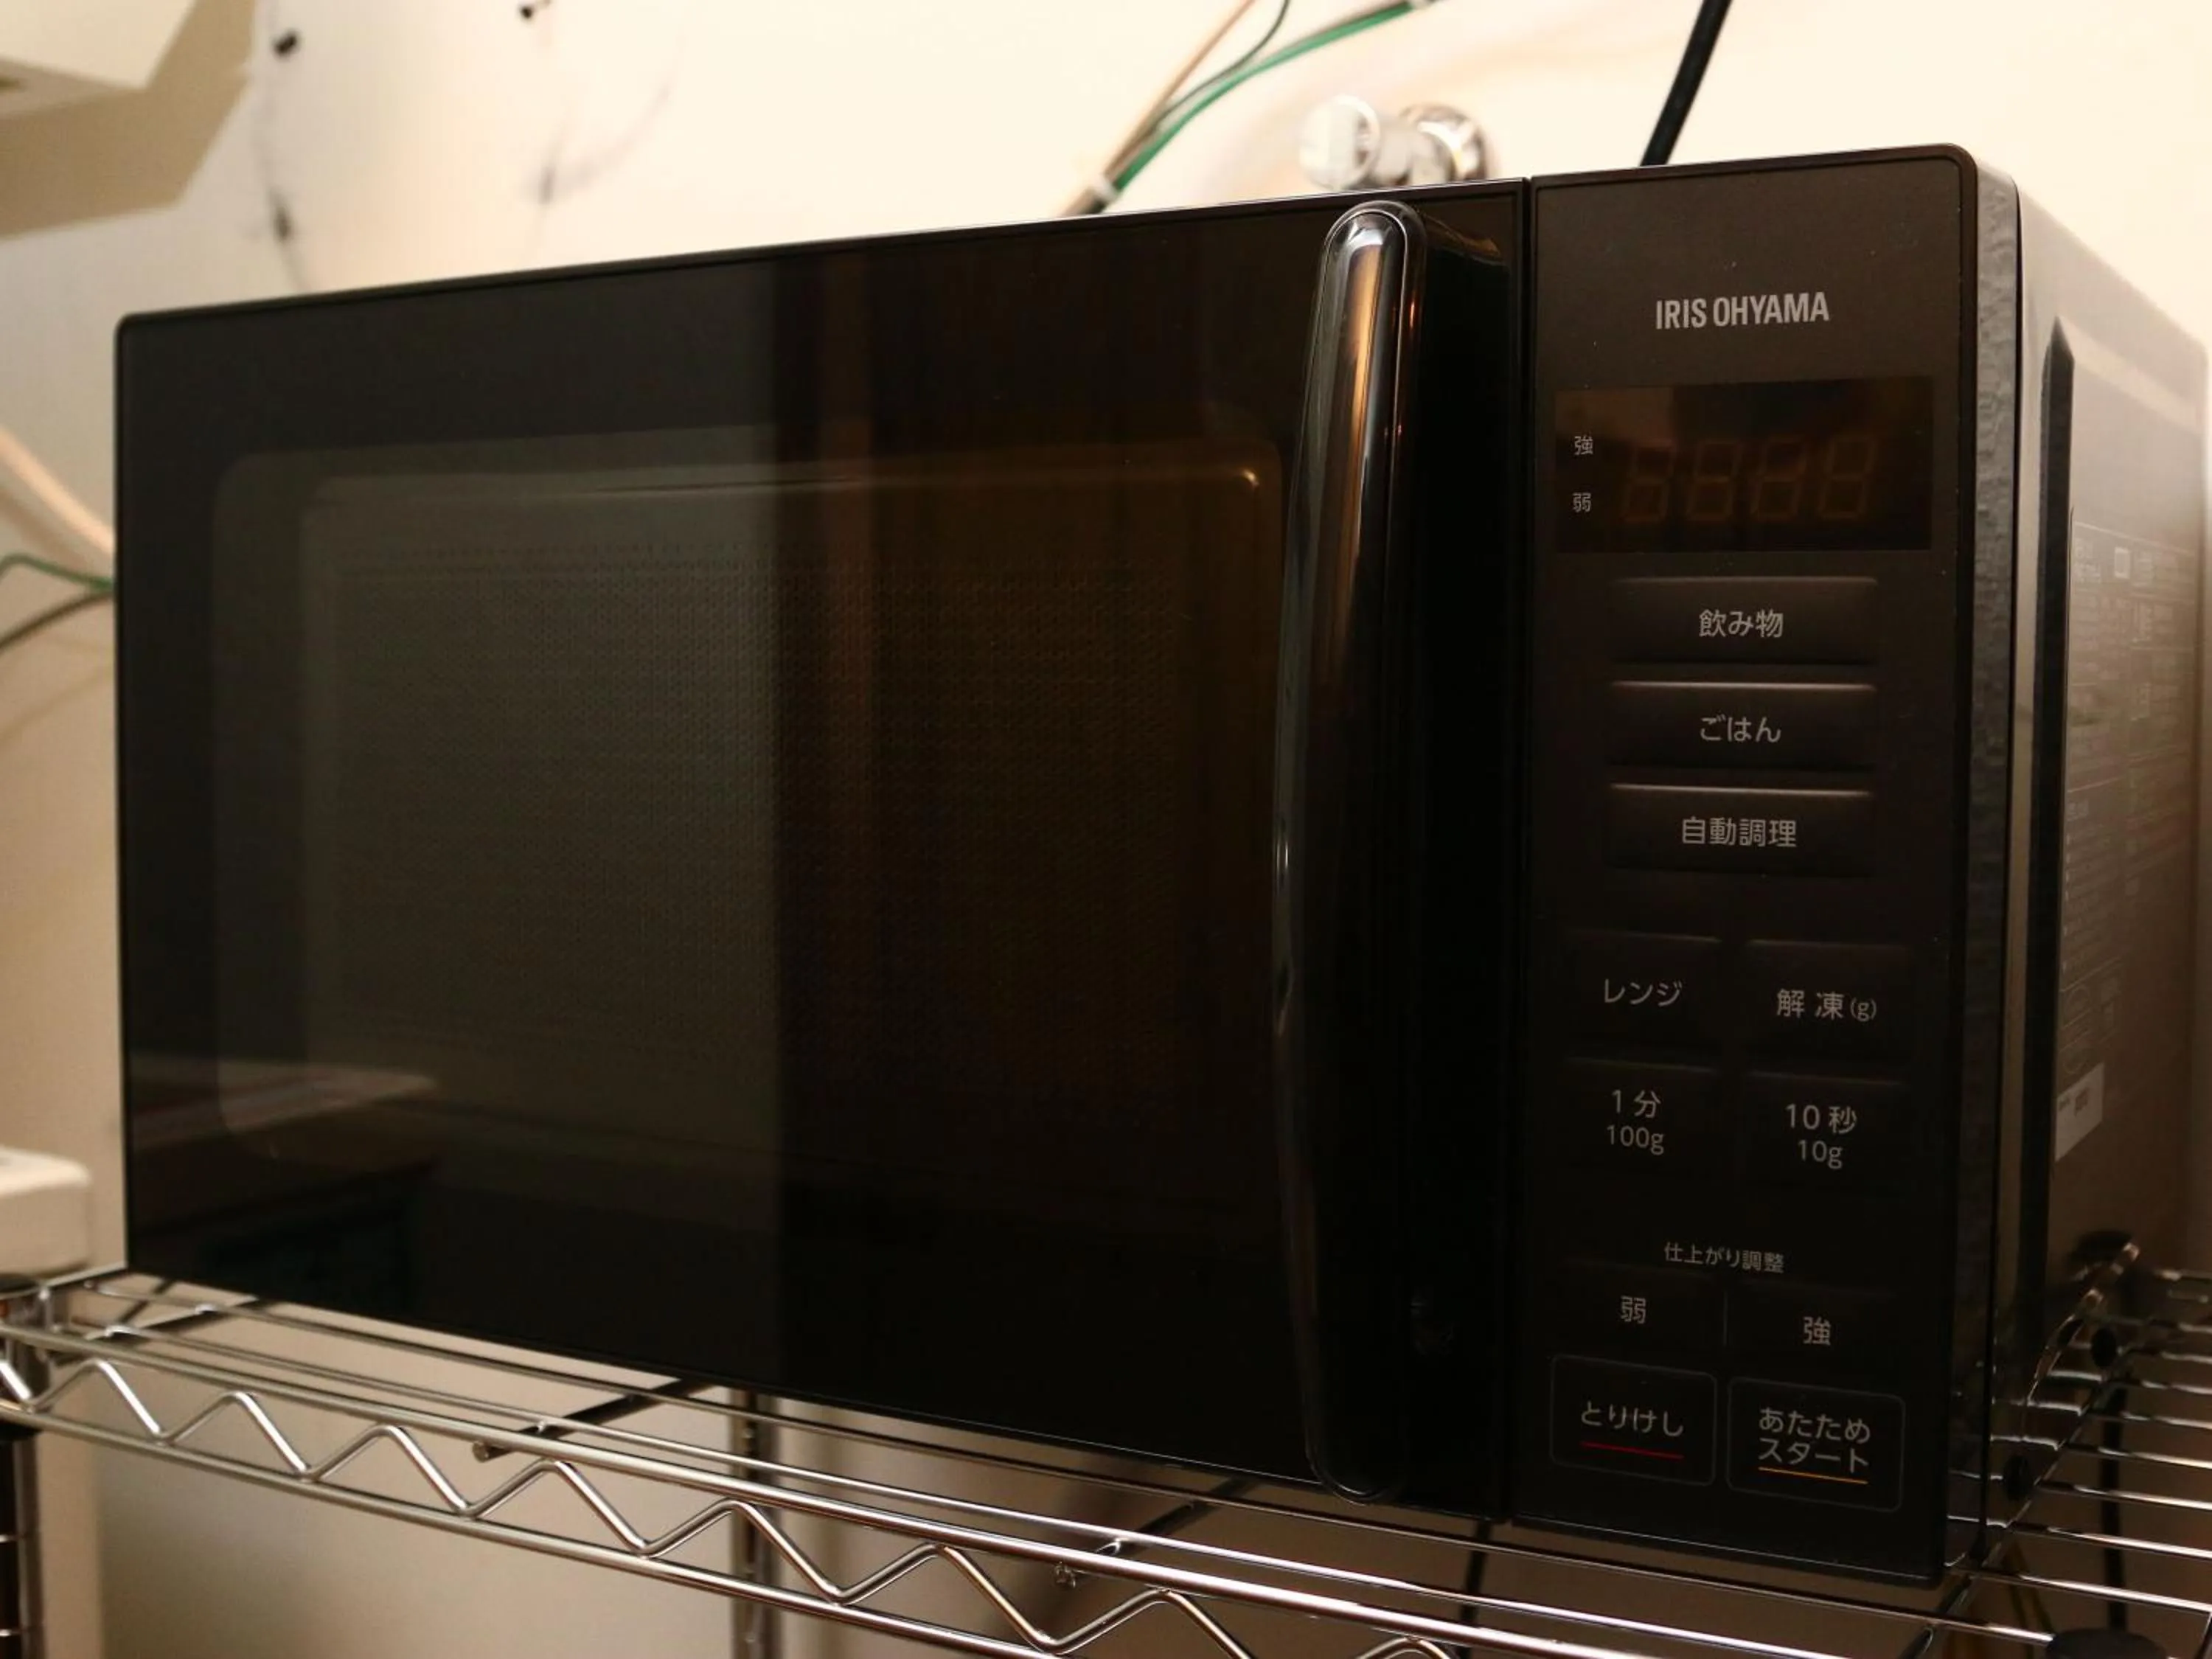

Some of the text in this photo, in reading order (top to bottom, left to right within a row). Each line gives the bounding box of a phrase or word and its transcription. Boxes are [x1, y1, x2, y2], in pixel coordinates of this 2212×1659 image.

[1656, 291, 1830, 330] IRIS OHYAMA
[1573, 435, 1593, 456] 強
[1572, 492, 1593, 512] 弱
[1699, 608, 1784, 638] 飲み物
[1700, 714, 1781, 743] ごはん
[1682, 816, 1798, 848] 自動調理
[1604, 978, 1683, 1007] レンジ
[1606, 1124, 1665, 1155] 100g
[1797, 1139, 1843, 1169] 10g
[1663, 1242, 1785, 1274] 仕上がり調整
[1620, 1295, 1646, 1324] 弱
[1803, 1317, 1832, 1346] 強
[1580, 1400, 1684, 1437] とりけし
[1759, 1407, 1871, 1444] あたため
[1759, 1437, 1870, 1473] スタート
